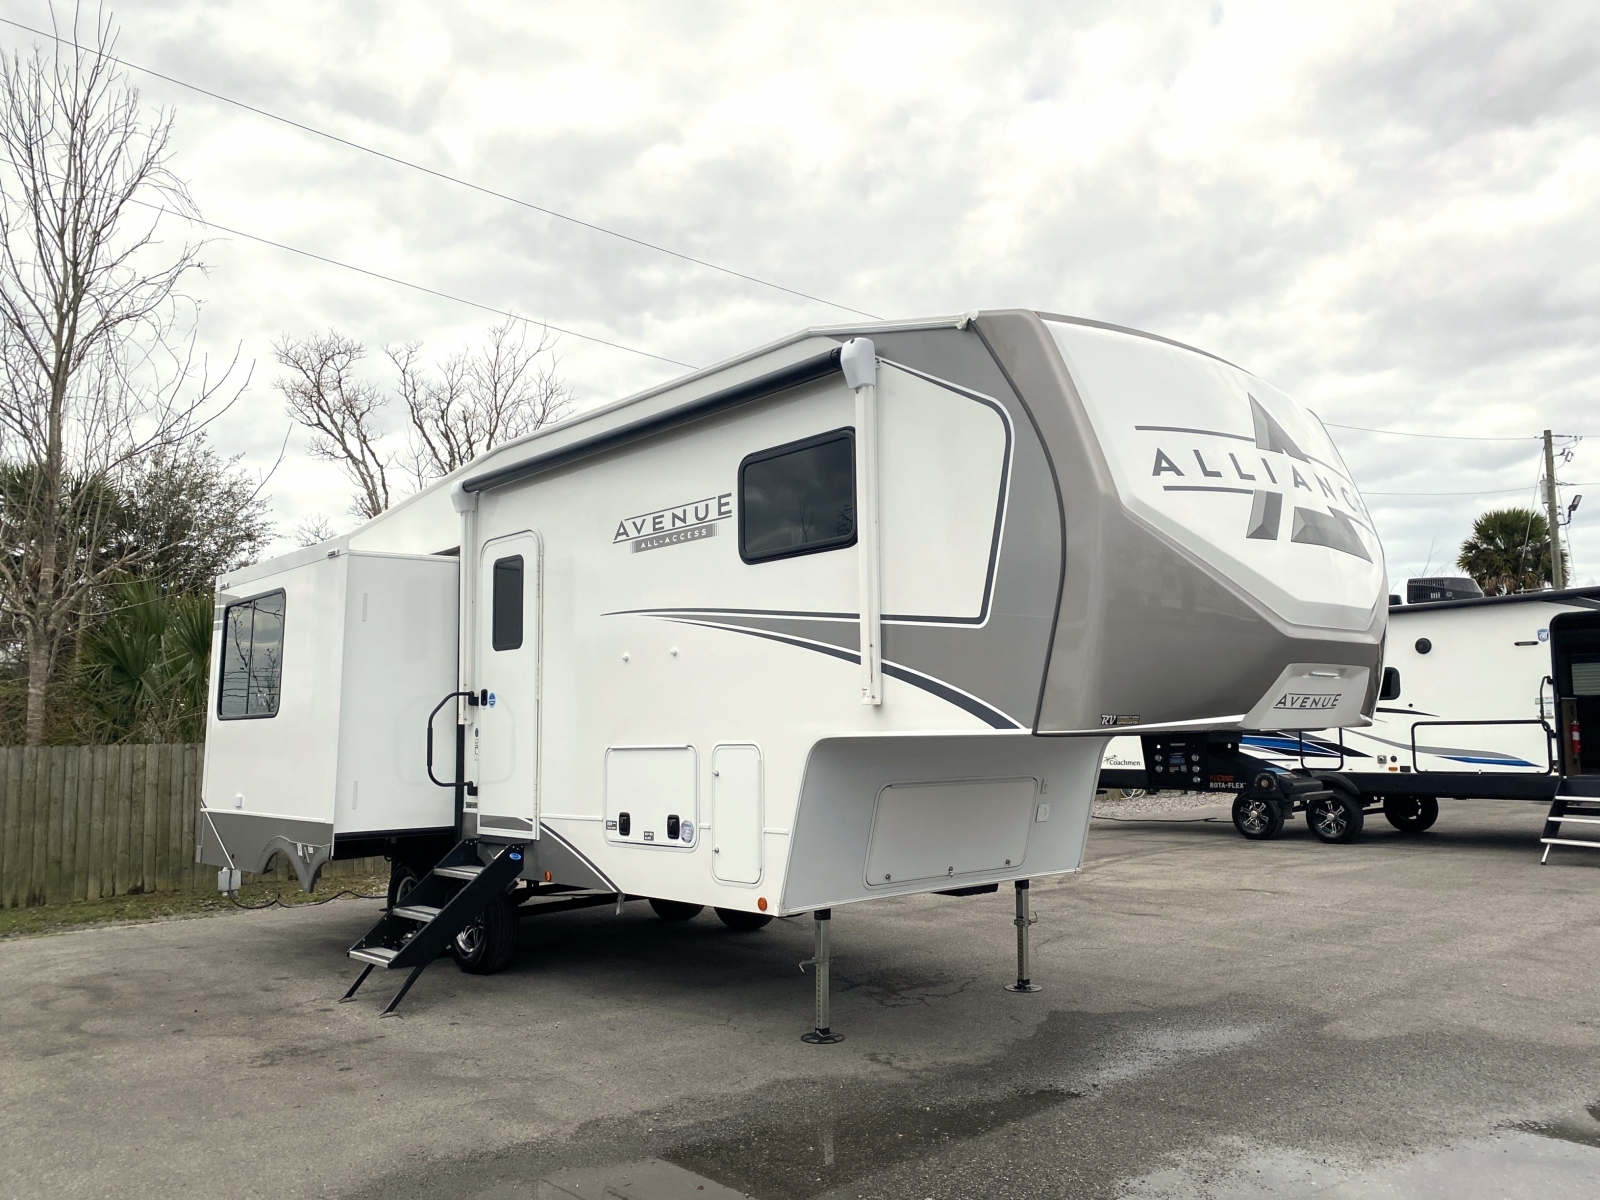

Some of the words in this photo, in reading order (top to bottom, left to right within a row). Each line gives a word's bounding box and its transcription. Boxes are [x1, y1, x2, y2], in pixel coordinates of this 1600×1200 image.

[614, 493, 732, 540] AVENUE
[641, 529, 707, 548] ALL-ACCESS
[1275, 693, 1342, 708] AVENUE
[1101, 714, 1117, 725] RV
